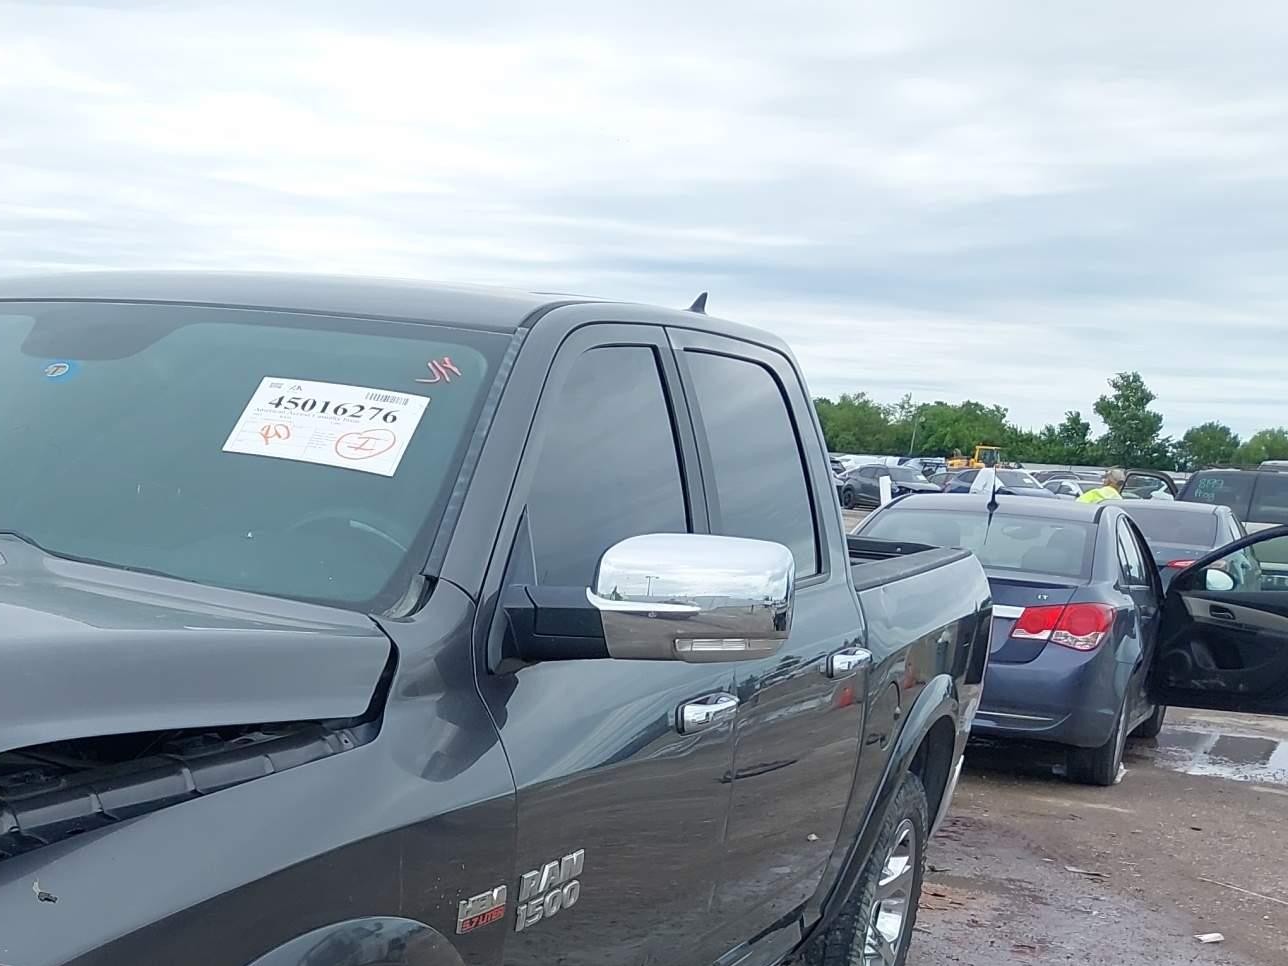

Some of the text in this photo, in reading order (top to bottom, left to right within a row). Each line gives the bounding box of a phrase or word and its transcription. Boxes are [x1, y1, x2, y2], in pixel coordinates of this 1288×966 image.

[268, 395, 400, 423] 45016276
[518, 848, 585, 903] RAM
[515, 879, 581, 933] 1500
